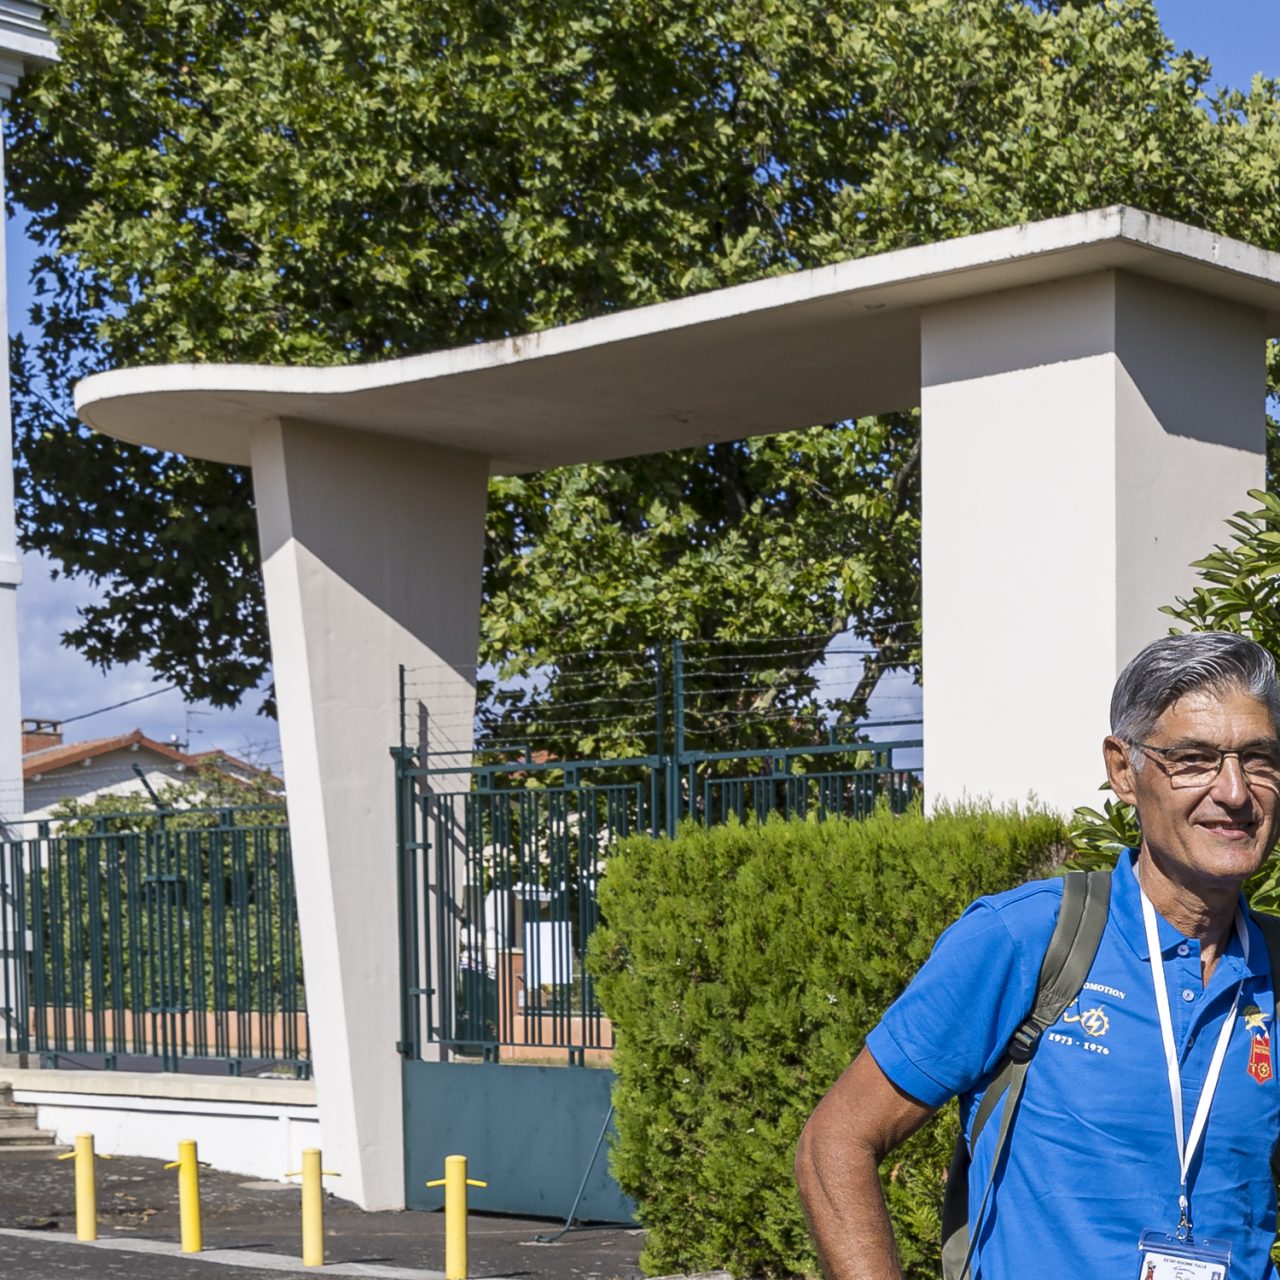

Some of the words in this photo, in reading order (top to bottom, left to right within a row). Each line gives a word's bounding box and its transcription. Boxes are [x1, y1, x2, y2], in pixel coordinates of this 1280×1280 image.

[1083, 982, 1126, 999] OMOTION
[1048, 1033, 1072, 1046] 1973
[1083, 1042, 1110, 1055] 1976
